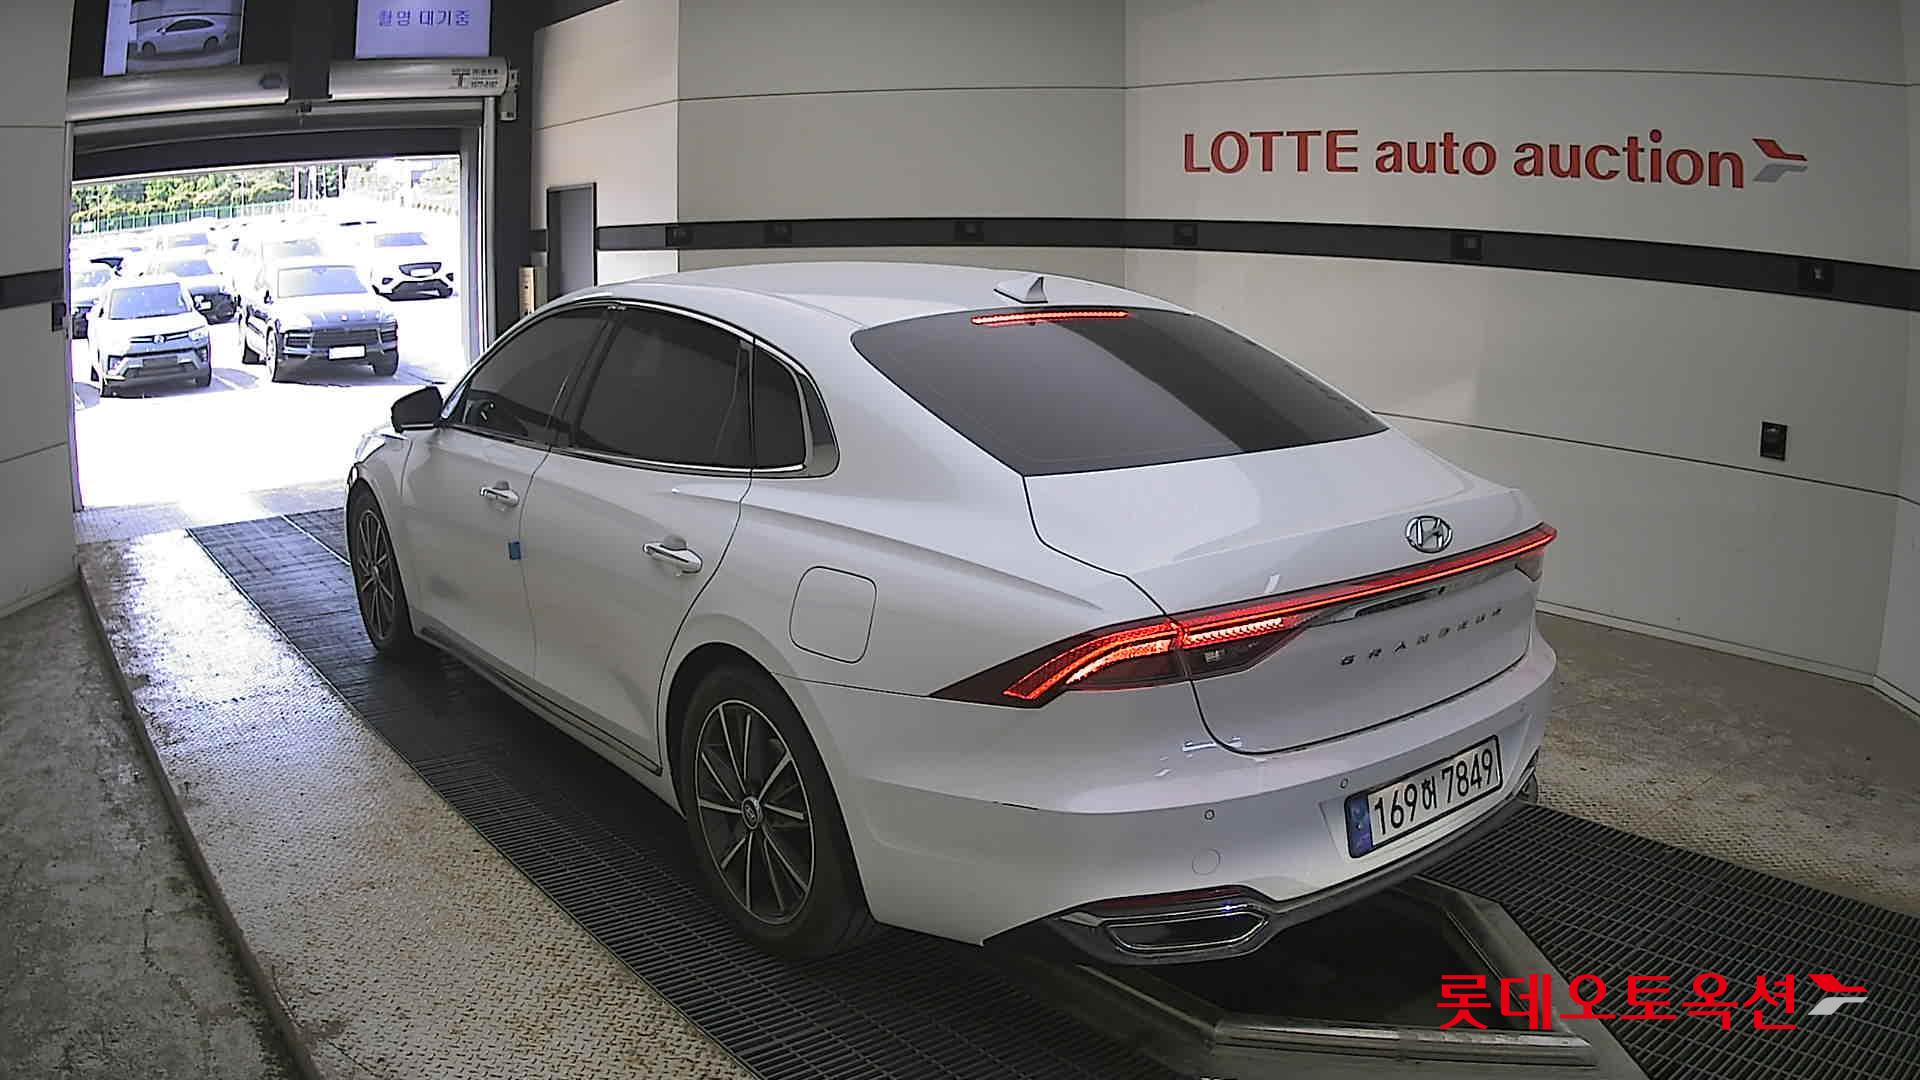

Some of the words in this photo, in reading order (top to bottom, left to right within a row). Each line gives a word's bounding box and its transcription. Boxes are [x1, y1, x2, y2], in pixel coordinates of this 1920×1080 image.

[419, 9, 471, 27] 대기중
[1184, 129, 1359, 174] LOTTE
[1376, 131, 1497, 177] auto
[1513, 129, 1745, 189] auction
[1374, 775, 1438, 836] 169허
[1441, 748, 1494, 805] 7849
